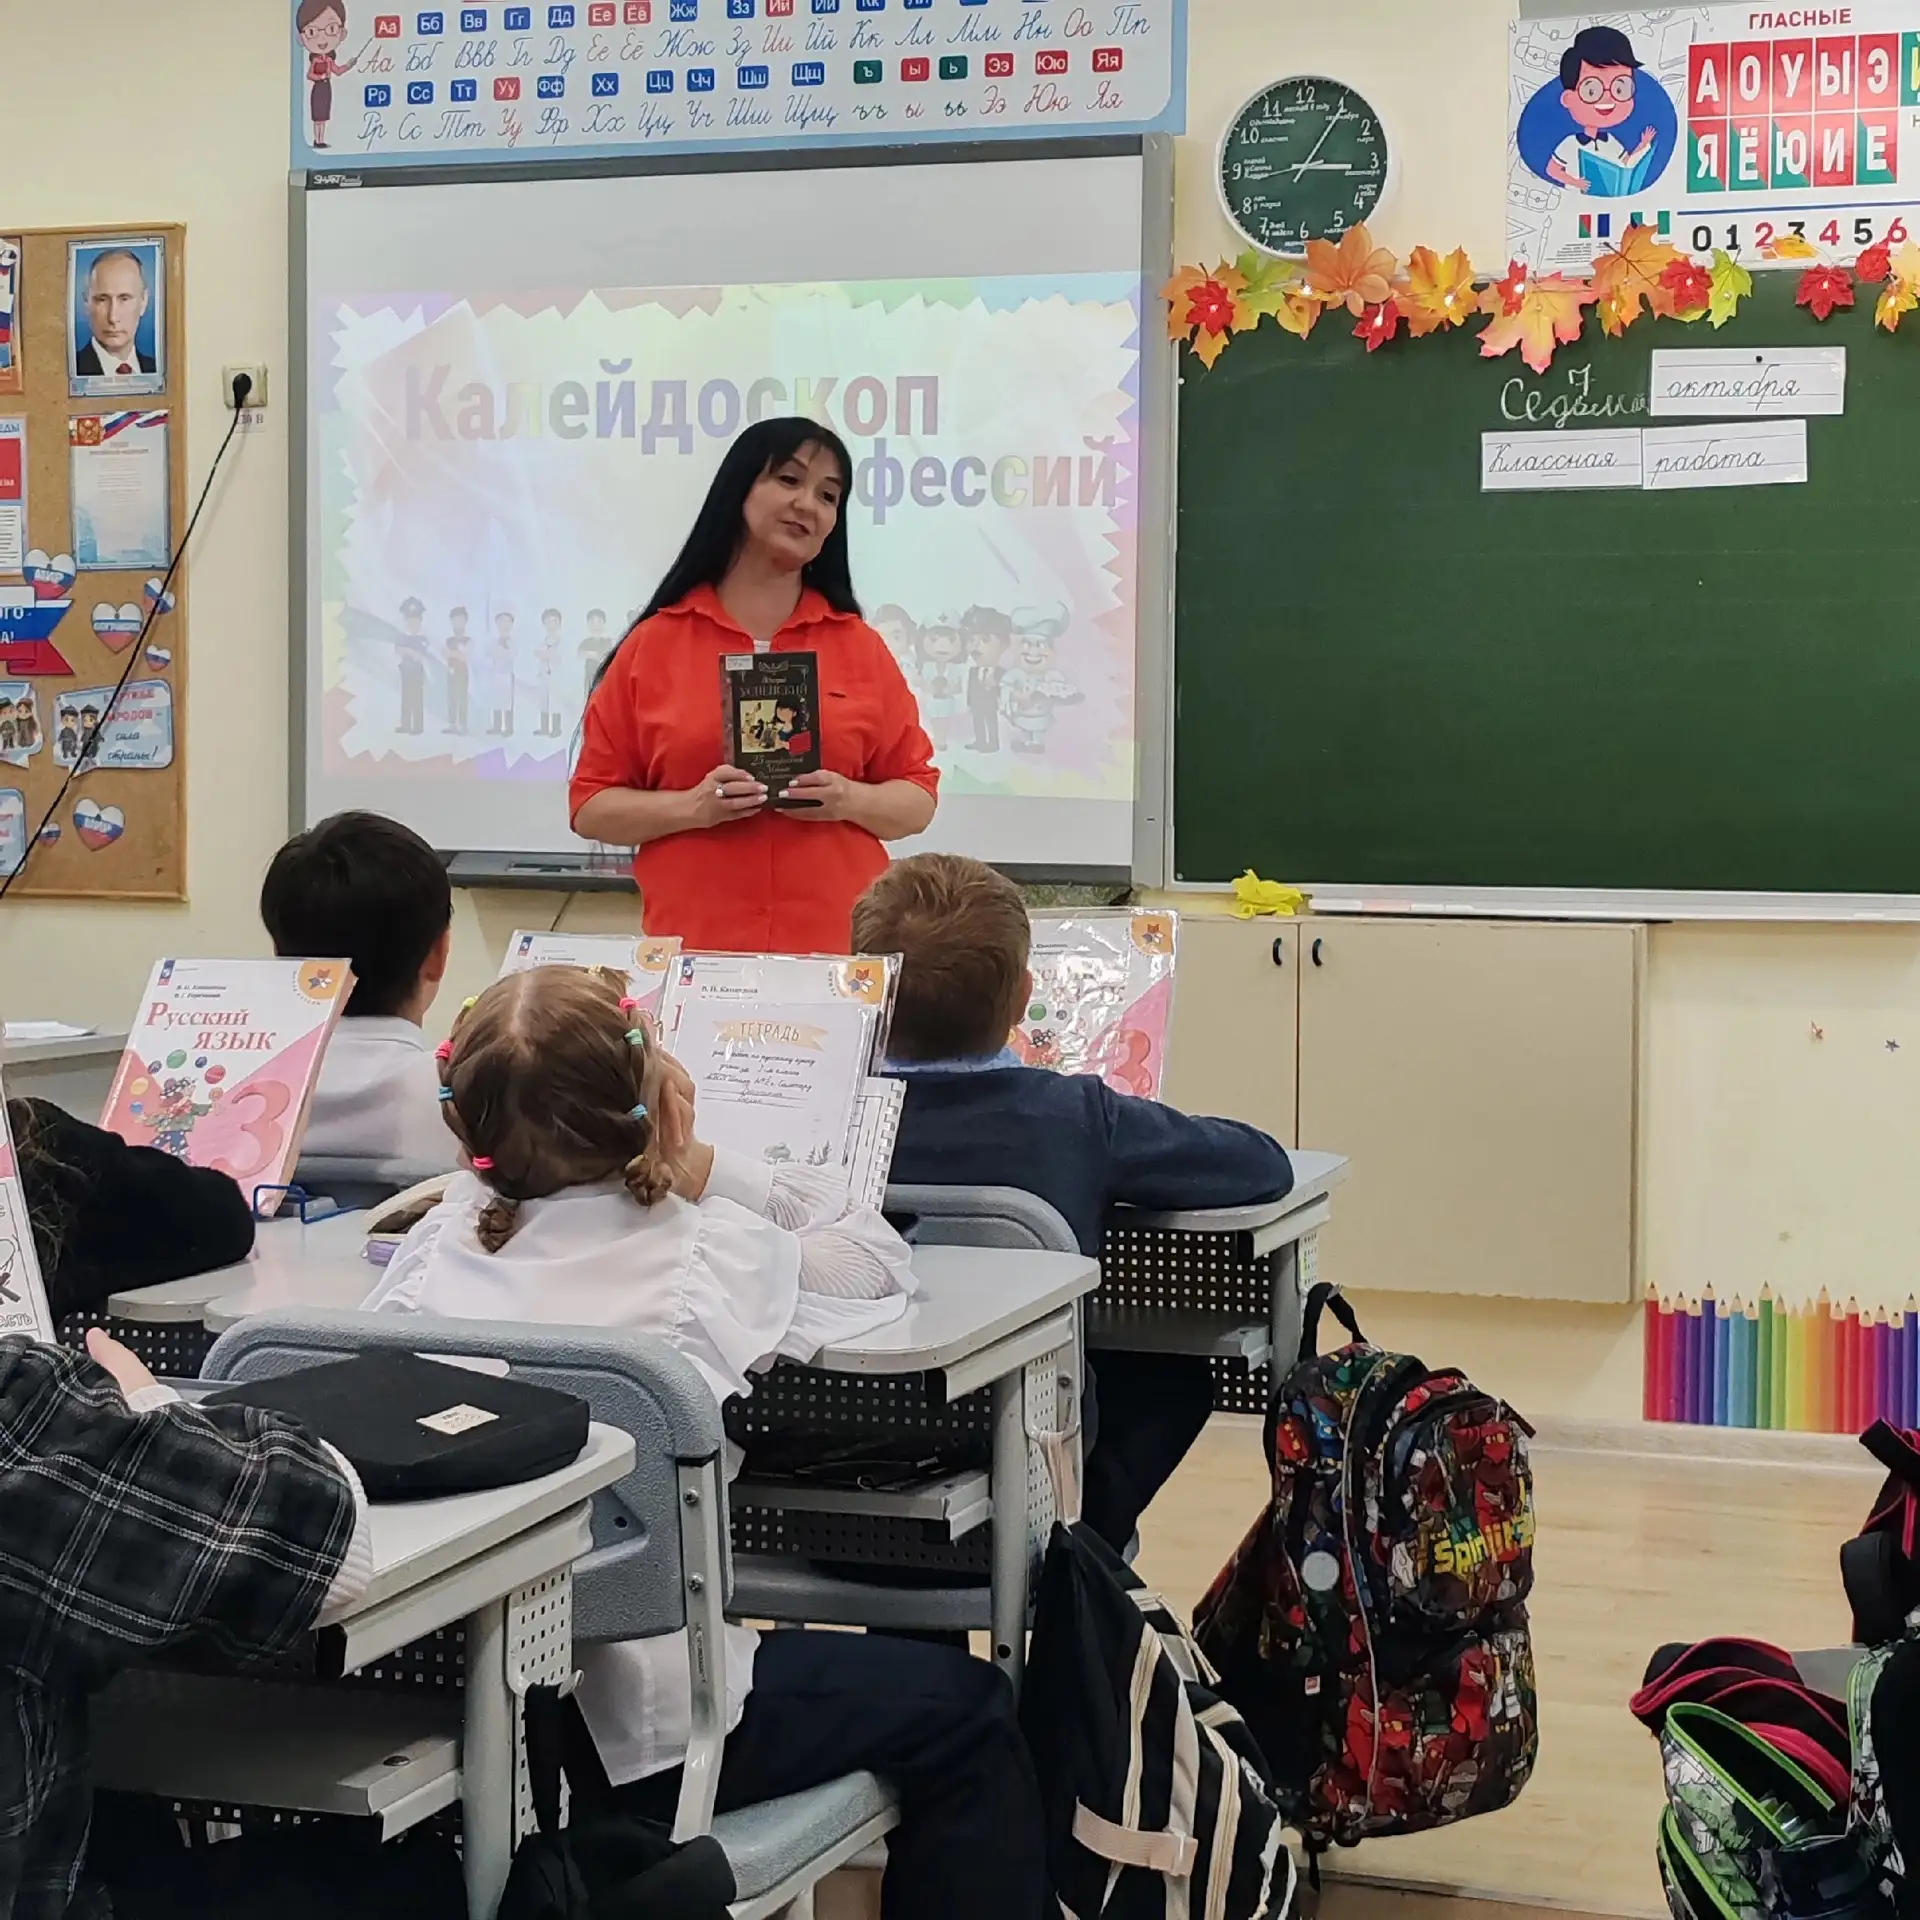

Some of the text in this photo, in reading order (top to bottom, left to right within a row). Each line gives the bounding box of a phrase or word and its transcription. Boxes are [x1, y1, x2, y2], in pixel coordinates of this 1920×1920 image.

[378, 20, 398, 35] Аа
[420, 16, 440, 31] Бб
[464, 14, 483, 28] Вв
[509, 12, 525, 27] Гг
[550, 8, 572, 25] Дд
[592, 7, 612, 22] Ее
[626, 5, 648, 21] Ёё
[670, 3, 697, 18] Жж
[732, 0, 750, 15] Зз
[1749, 8, 1852, 30] ГЛАСНЫЕ
[358, 44, 396, 74] Аа
[405, 41, 444, 72] Бб
[506, 37, 533, 67] Гг
[543, 35, 577, 75] Дд
[586, 33, 611, 62] Ее
[620, 28, 644, 61] Ёё
[654, 28, 716, 58] Жж
[725, 25, 752, 67] Зз
[762, 23, 794, 54] Ии
[805, 17, 838, 51] Йй
[849, 18, 884, 49] Кк
[894, 16, 935, 46] Лл
[946, 13, 1001, 43] Мм
[1013, 9, 1052, 41] Нн
[1063, 7, 1095, 38] Оо
[1106, 4, 1151, 36] Пп
[368, 53, 1119, 104] Рр Сс Тт Уу Фф Хх Цц Чч Шш Щщ ъ ы ь Ээ Юю Яя
[1695, 58, 1720, 103] А
[1739, 55, 1761, 101] О
[1780, 52, 1805, 98] У
[1820, 50, 1850, 96] Ы
[1867, 47, 1889, 94] Э
[1295, 86, 1316, 104] 12
[1338, 96, 1347, 113] 1
[357, 110, 388, 150] Рр
[398, 112, 423, 140] Сс
[433, 109, 486, 140] Тт
[497, 107, 523, 148] Уу
[535, 106, 570, 145] Фф
[581, 104, 626, 133] Хх
[637, 101, 675, 138] Цц
[686, 99, 716, 128] Чч
[726, 97, 772, 126] Шш
[784, 93, 839, 129] Щщ
[905, 102, 925, 119] ы
[979, 84, 1007, 114] Ээ
[1024, 82, 1072, 113] Юю
[1086, 80, 1123, 110] Яя
[1262, 100, 1282, 118] 11
[1240, 127, 1259, 144] 10
[1361, 118, 1371, 135] 2
[1370, 151, 1379, 169] 3
[1696, 125, 1887, 181] Я Ё Ю И Е
[1232, 162, 1241, 180] 9
[1242, 197, 1252, 215] 8
[1353, 192, 1364, 210] 4
[1258, 216, 1268, 234] 7
[1300, 221, 1309, 238] 6
[1333, 210, 1344, 227] 5
[1692, 225, 1712, 251] 0
[1726, 224, 1740, 251] 1
[1755, 222, 1774, 248] 2
[1819, 219, 1840, 246] 4
[1854, 218, 1873, 245] 5
[1887, 217, 1907, 244] 6
[1568, 364, 1596, 396] 7
[1667, 364, 1800, 411] октября
[405, 358, 938, 454] Калейдоскоп
[1489, 440, 1765, 486] Классная работа
[855, 436, 1118, 525] фессий
[0, 607, 24, 620] ГО
[146, 1002, 250, 1030] Русский
[210, 1080, 291, 1180] 3
